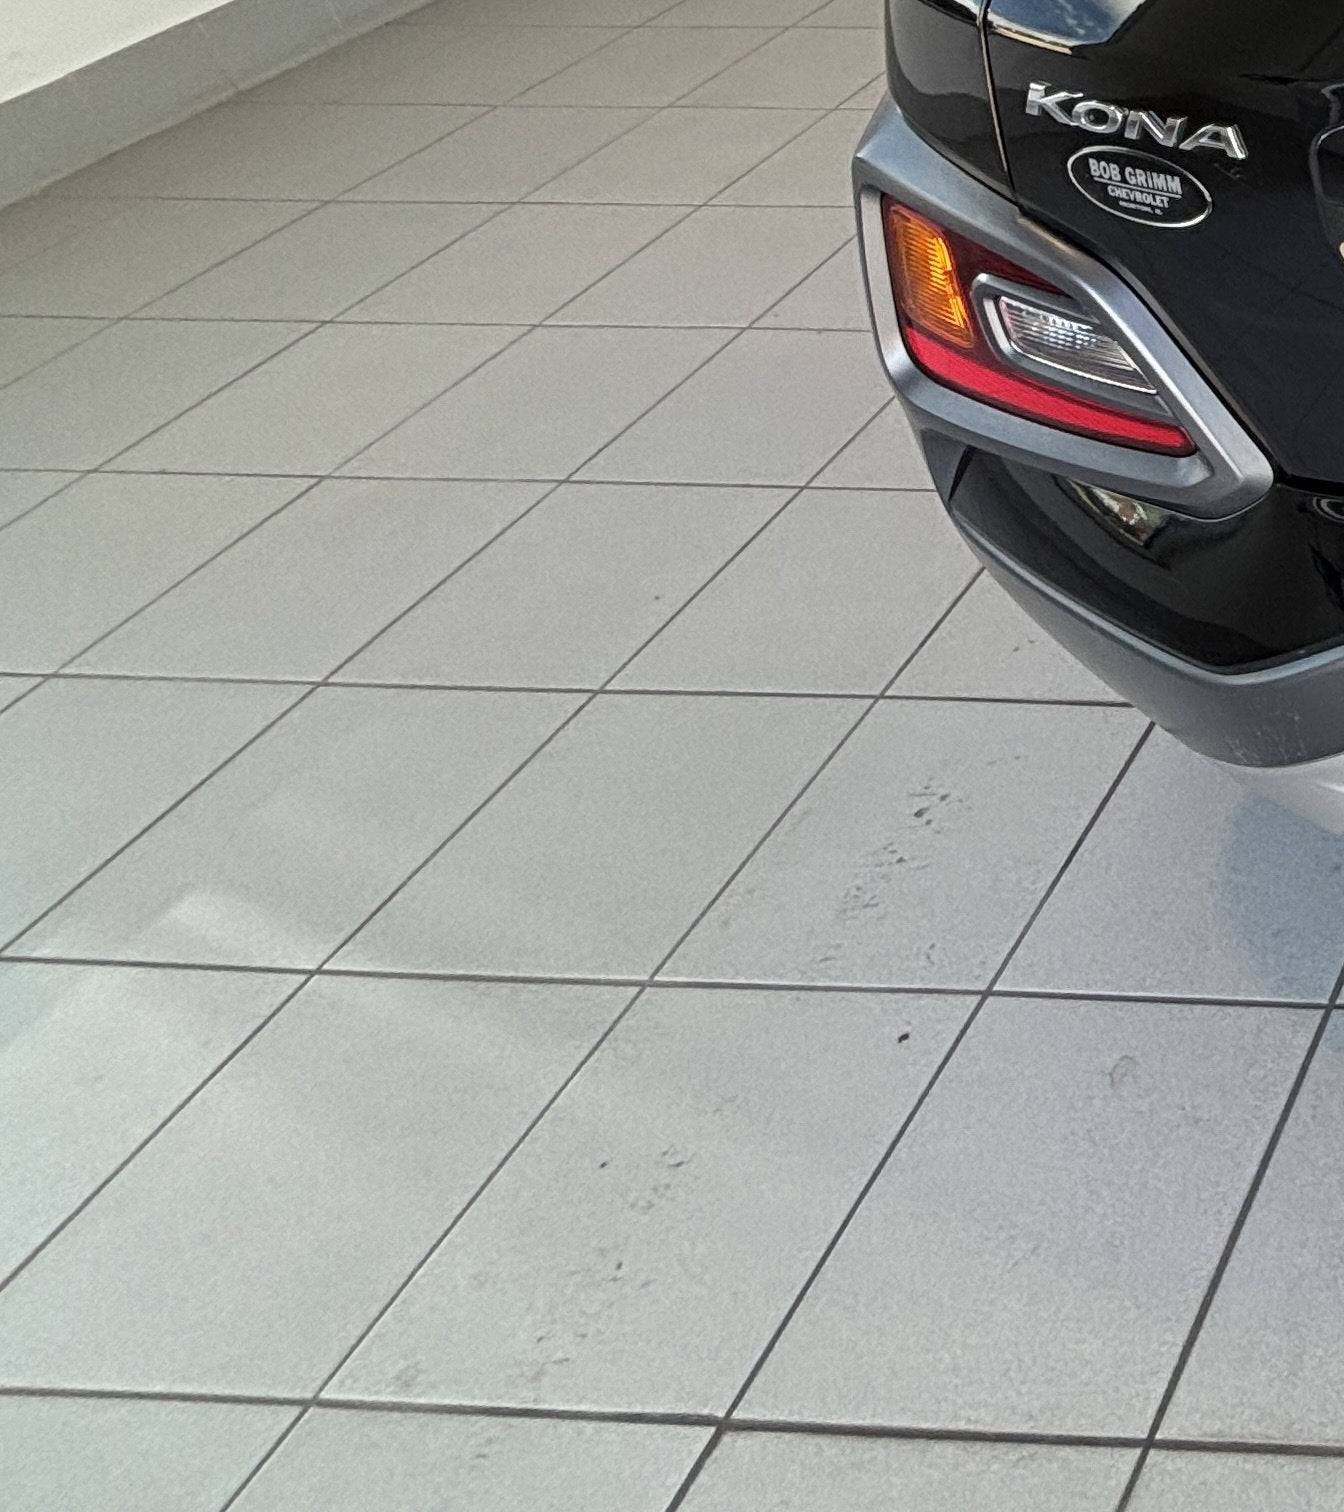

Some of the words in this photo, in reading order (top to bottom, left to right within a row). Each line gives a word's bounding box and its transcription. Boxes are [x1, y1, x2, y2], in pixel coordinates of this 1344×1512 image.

[1025, 80, 1249, 161] KONA
[1088, 157, 1121, 182] BOB
[1124, 166, 1183, 195] GRIMM
[1107, 185, 1169, 208] CHEVROLET
